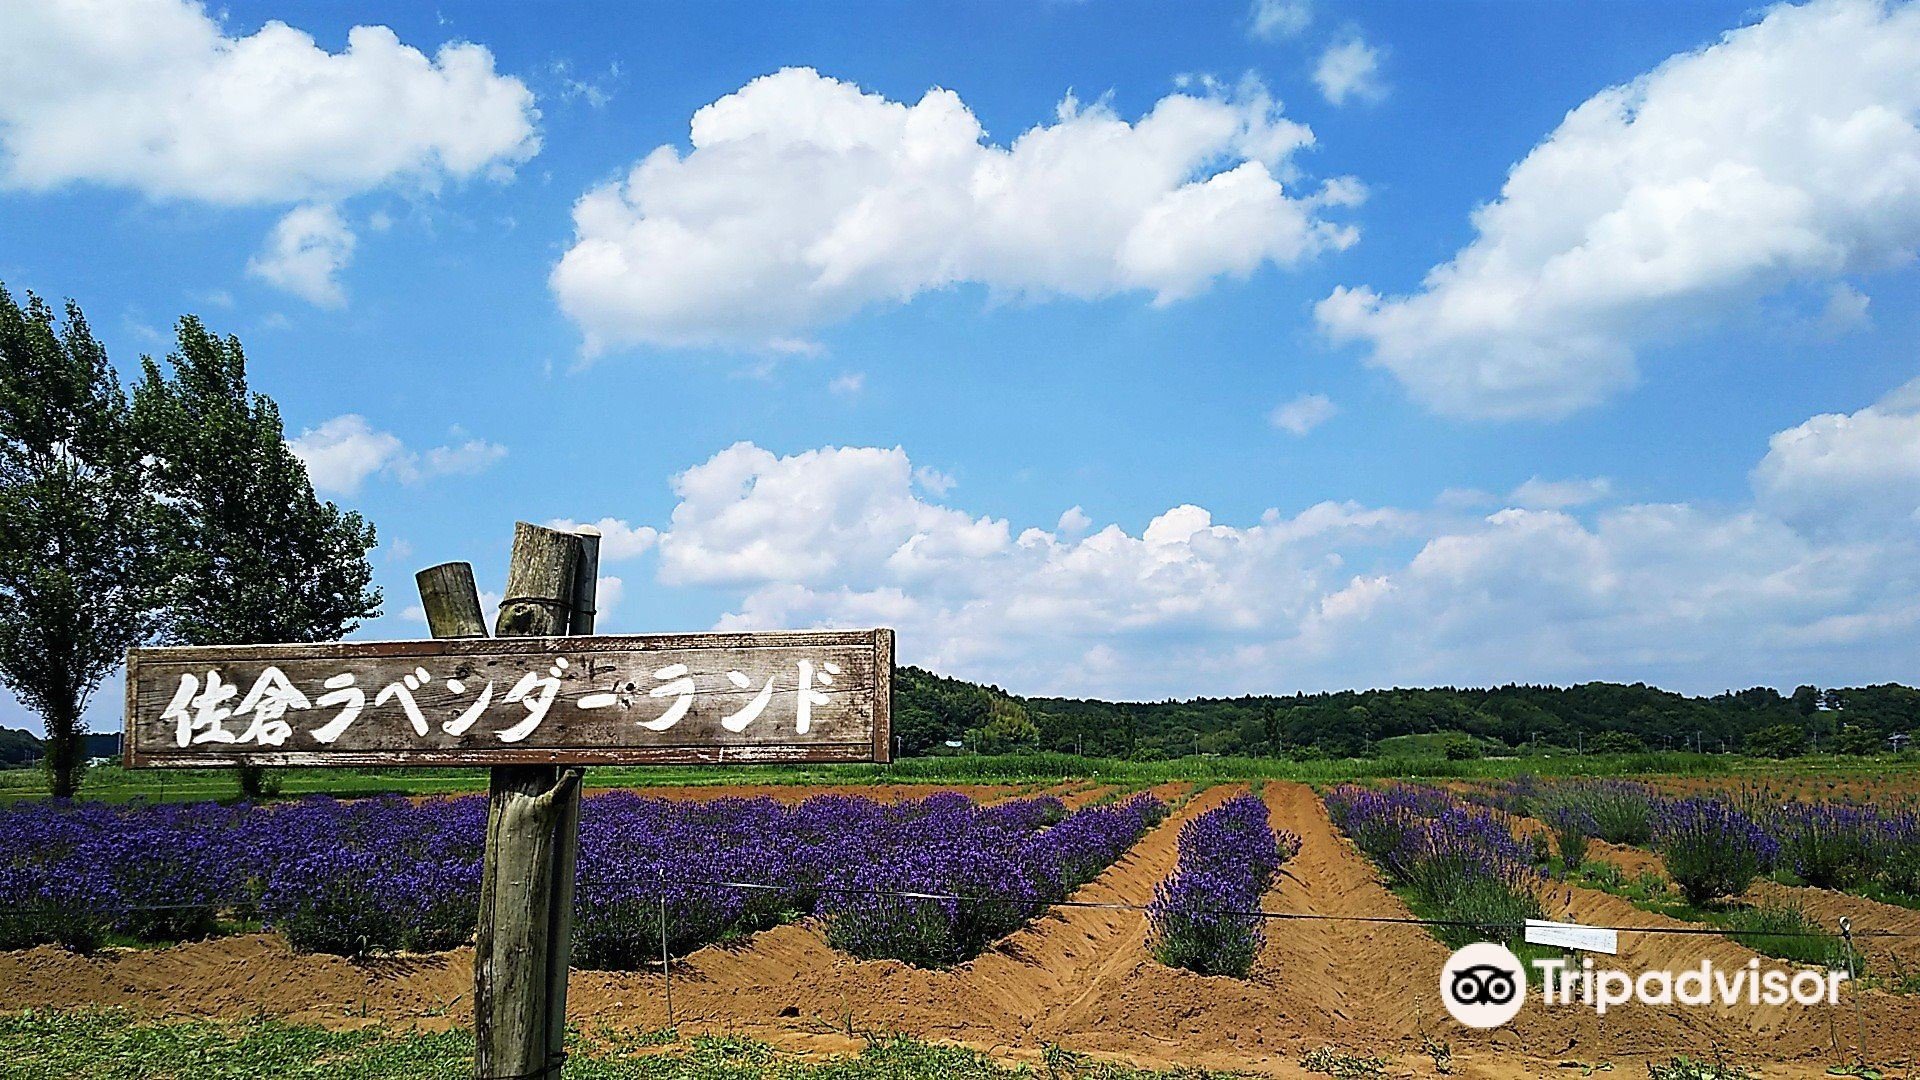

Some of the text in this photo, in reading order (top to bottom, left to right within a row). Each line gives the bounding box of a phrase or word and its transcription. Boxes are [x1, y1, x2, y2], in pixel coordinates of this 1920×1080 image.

[159, 656, 842, 748] 佐倉ラベンダーランド
